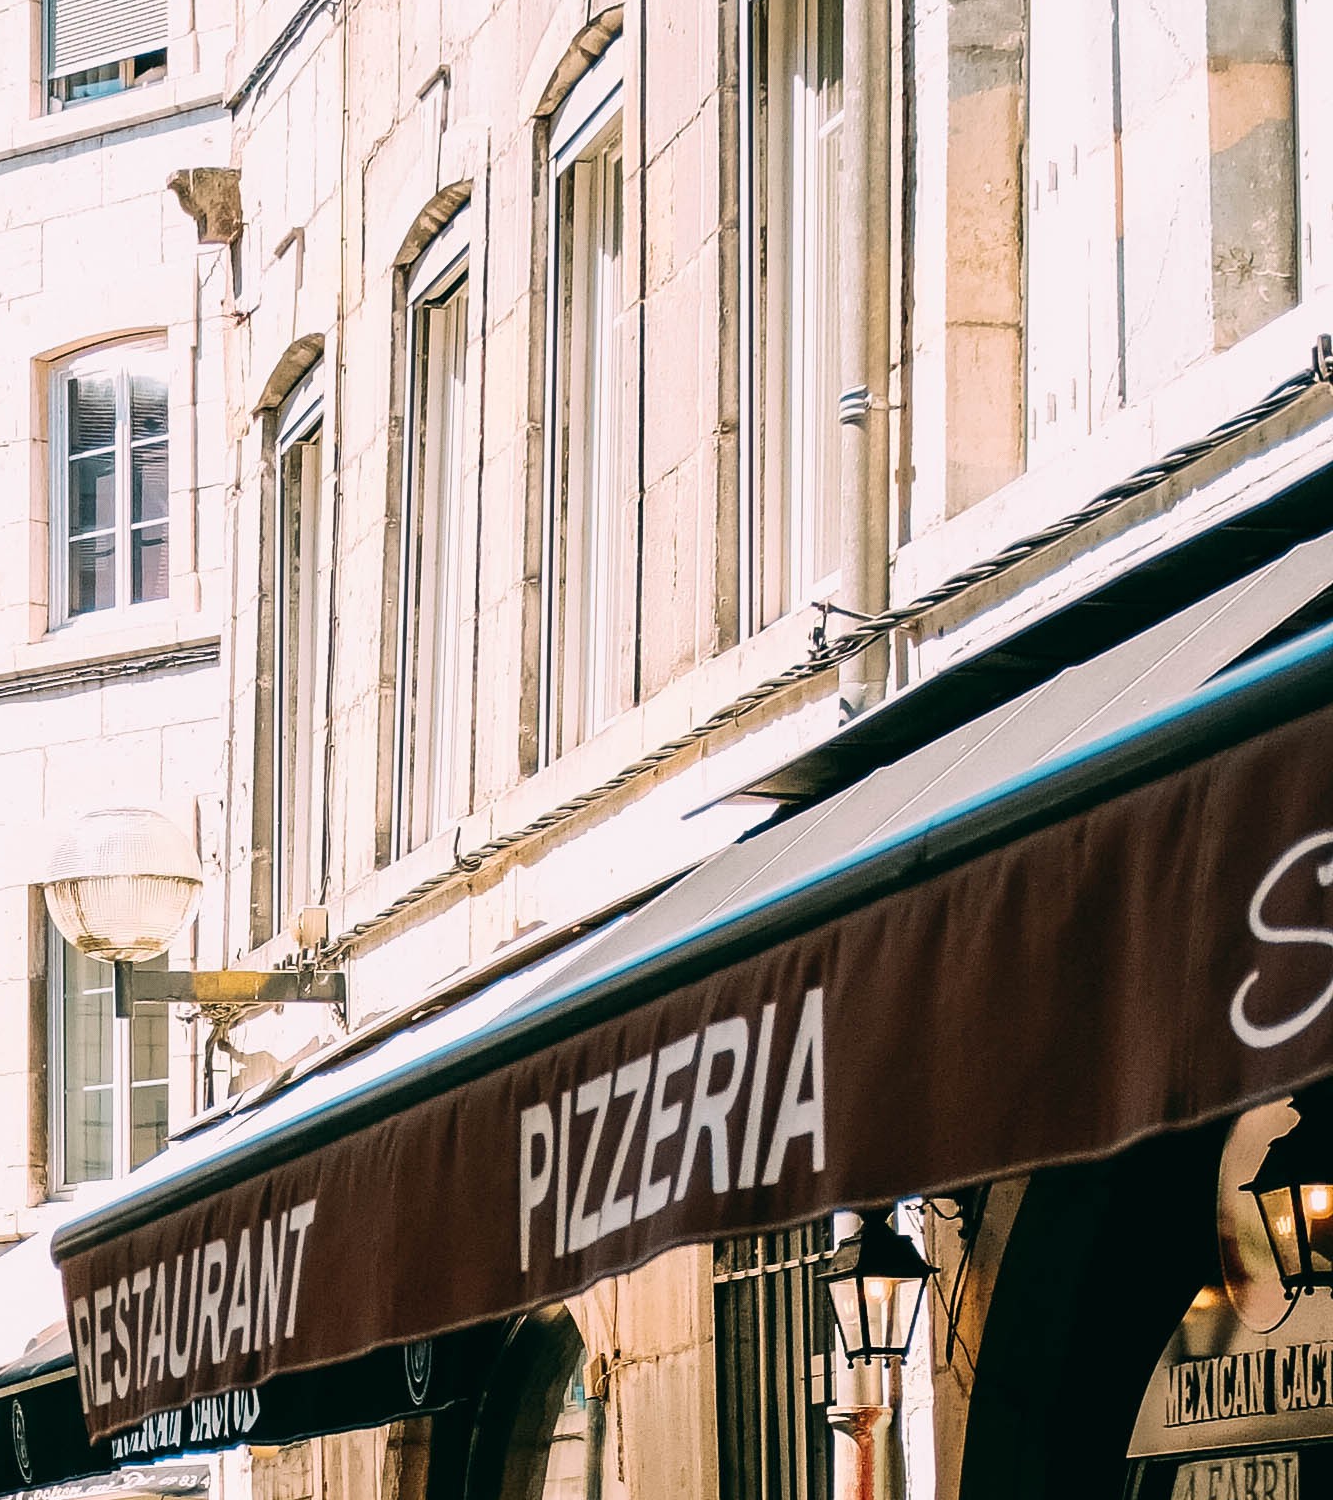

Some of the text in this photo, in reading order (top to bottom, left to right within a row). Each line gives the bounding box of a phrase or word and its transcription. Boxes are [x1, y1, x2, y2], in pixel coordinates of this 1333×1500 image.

[520, 987, 826, 1273] PIZZERIA
[73, 1199, 317, 1415] RESTAURANT
[1164, 1350, 1267, 1428] MEXICAN
